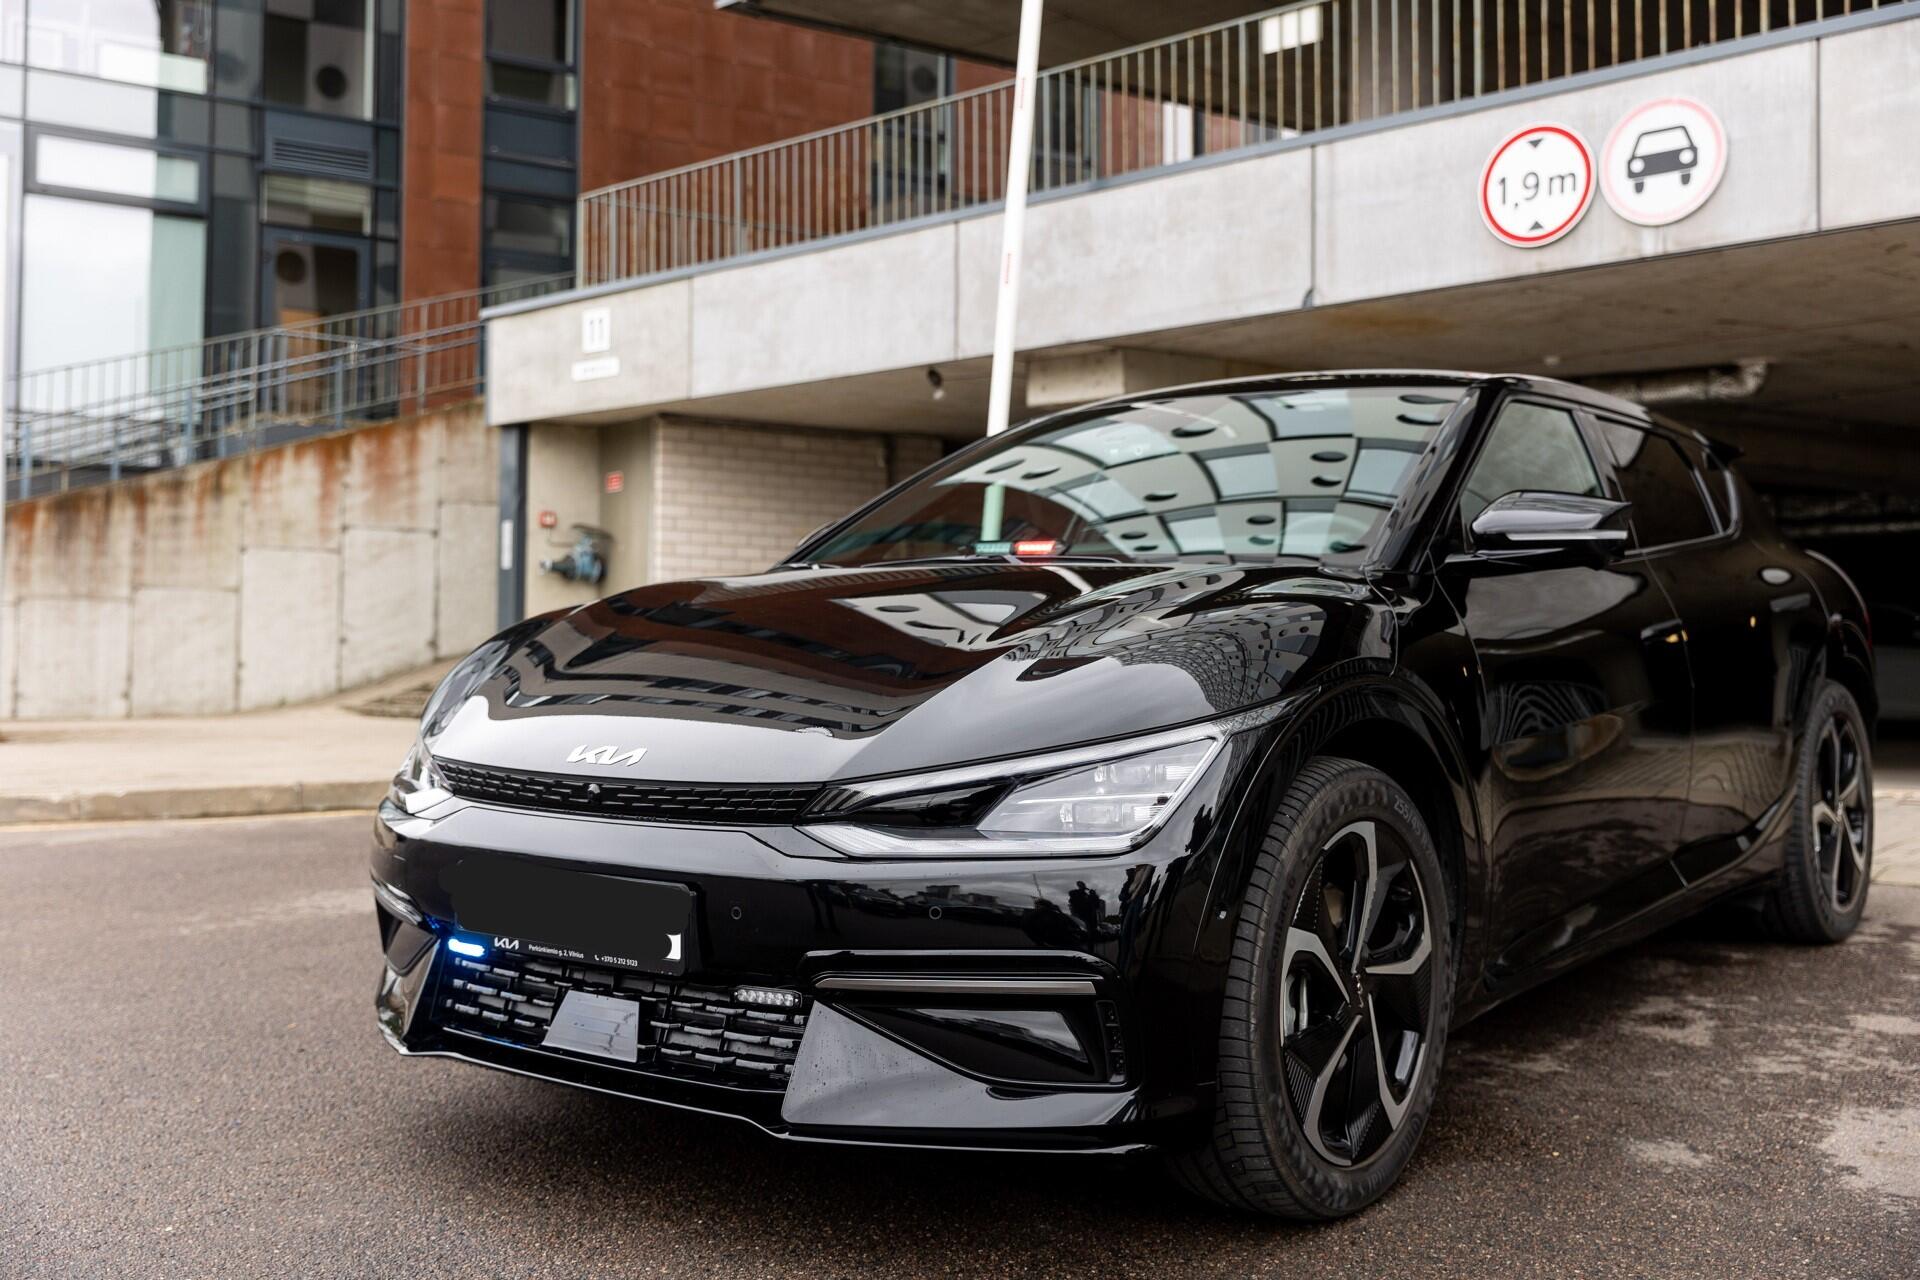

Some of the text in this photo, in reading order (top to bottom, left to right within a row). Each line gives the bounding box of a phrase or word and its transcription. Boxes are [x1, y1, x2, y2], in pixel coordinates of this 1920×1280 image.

[566, 744, 648, 767] KIA
[494, 936, 519, 951] KIA
[601, 955, 613, 963] +370
